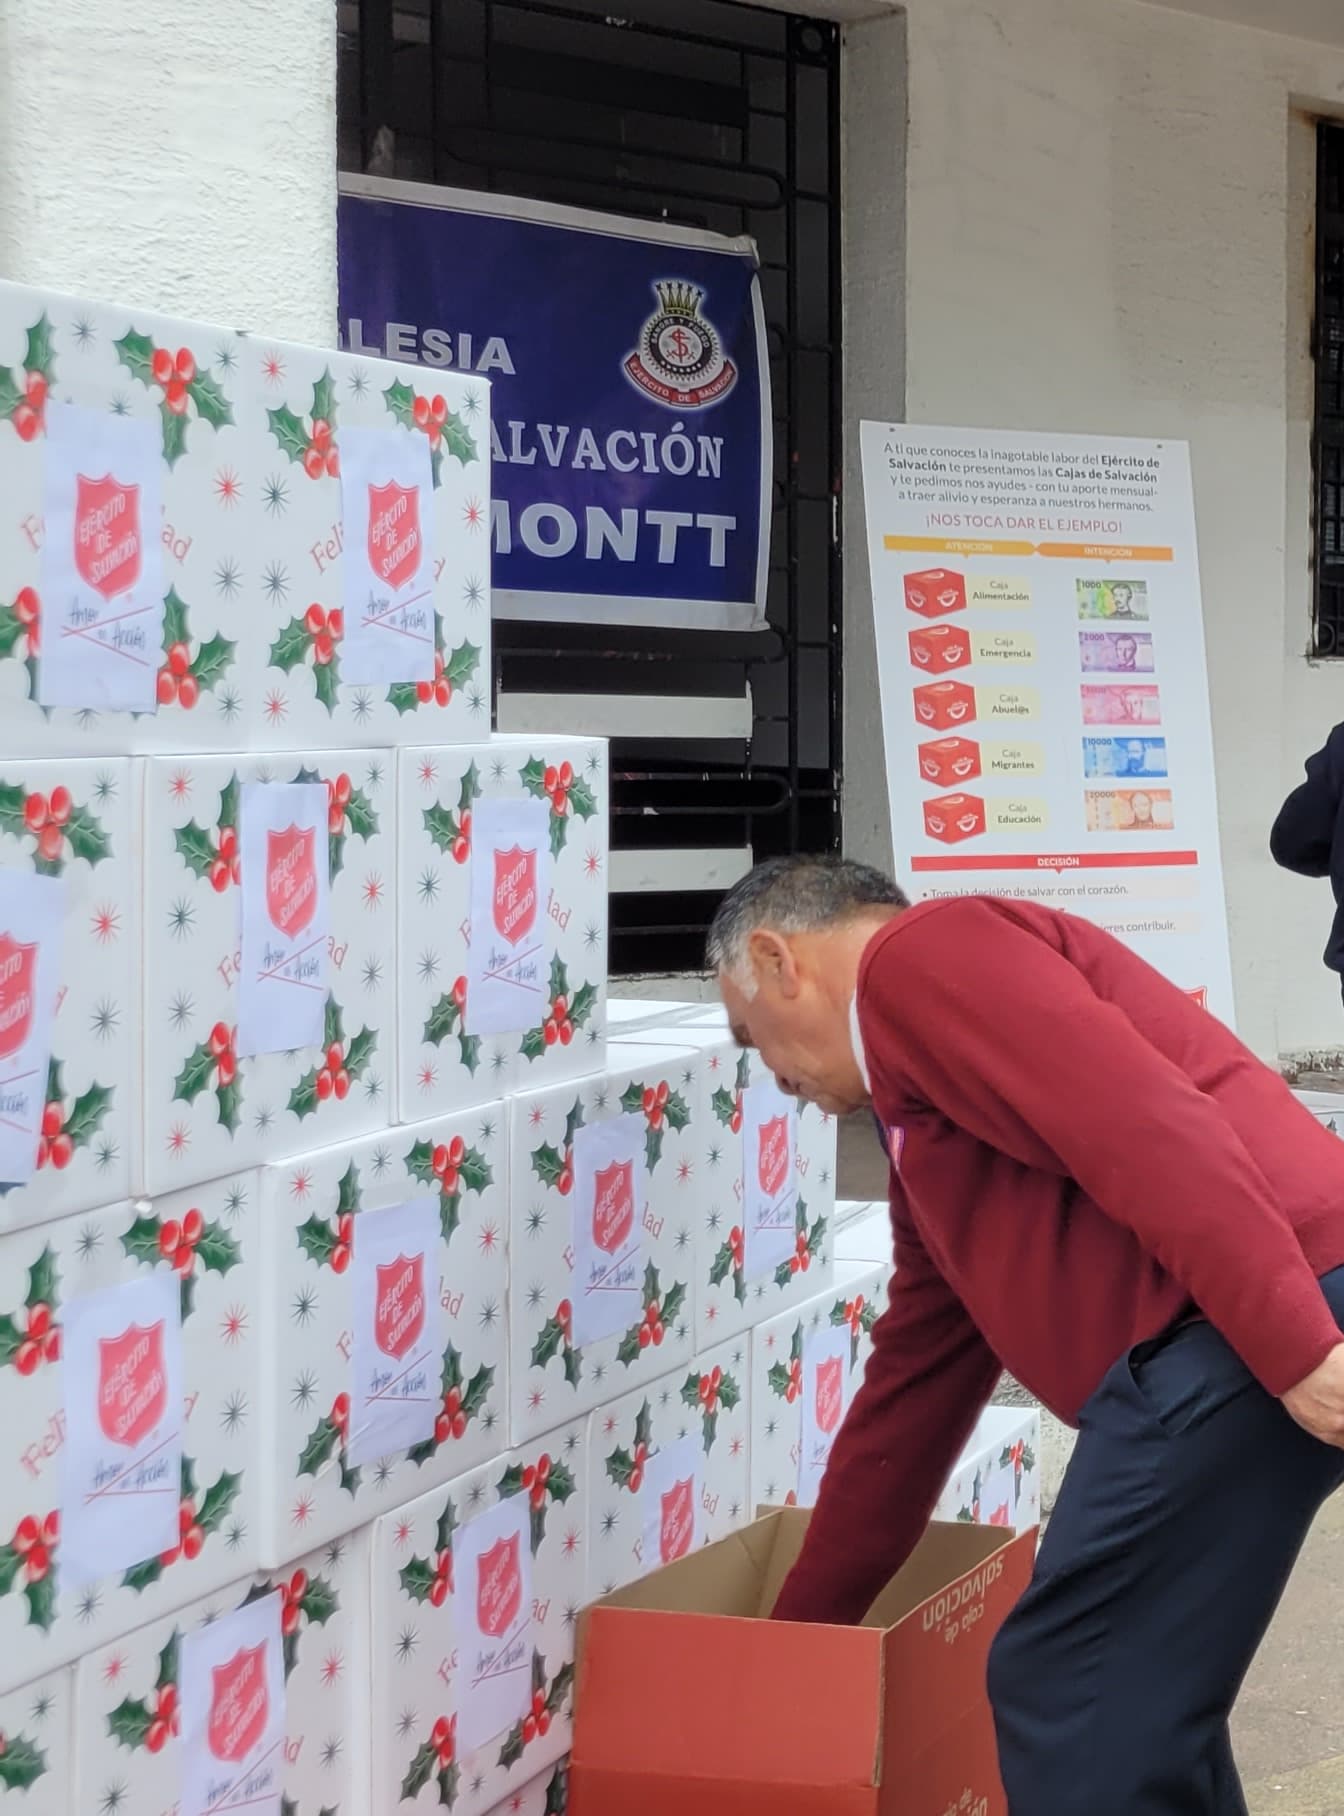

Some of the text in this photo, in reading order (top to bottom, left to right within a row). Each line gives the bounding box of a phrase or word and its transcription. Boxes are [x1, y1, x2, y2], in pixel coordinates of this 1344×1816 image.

[338, 318, 516, 375] LESIA
[677, 393, 691, 402] DE
[884, 442, 1160, 469] A ti que conoces la inagotable labor del Ejército de
[888, 458, 1158, 483] Salvación te presentamos las Cajas de Salvación
[890, 475, 898, 486] y
[900, 473, 912, 485] te
[914, 475, 962, 488] pedimos
[965, 479, 985, 489] nos
[987, 479, 1027, 492] ayudes
[1035, 482, 1055, 492] con
[1058, 481, 1069, 493] tu
[1071, 483, 1108, 495] aporte
[898, 489, 1153, 512] a traer alivio y esperanza a nuestros hermanos.
[925, 513, 1122, 535] ¡NOS TOCA DAR EL EJEMPLO!
[97, 531, 113, 554] DE
[385, 528, 398, 550] DE
[990, 580, 1008, 590] Caja
[972, 591, 1029, 601] Alimentación
[994, 636, 1014, 647] Caja
[980, 648, 1032, 660] Emergencia
[999, 693, 1019, 704] Caja
[1002, 748, 1021, 759] Caja
[991, 759, 1035, 770] Migrantes
[1008, 803, 1027, 813] Caja
[997, 814, 1042, 824] Educación
[1036, 856, 1080, 867] DECISIÓN
[1015, 887, 1025, 897] de
[1027, 887, 1055, 897] salvar
[1057, 887, 1075, 896] con
[1077, 885, 1086, 895] el
[1126, 919, 1176, 932] contribuir.
